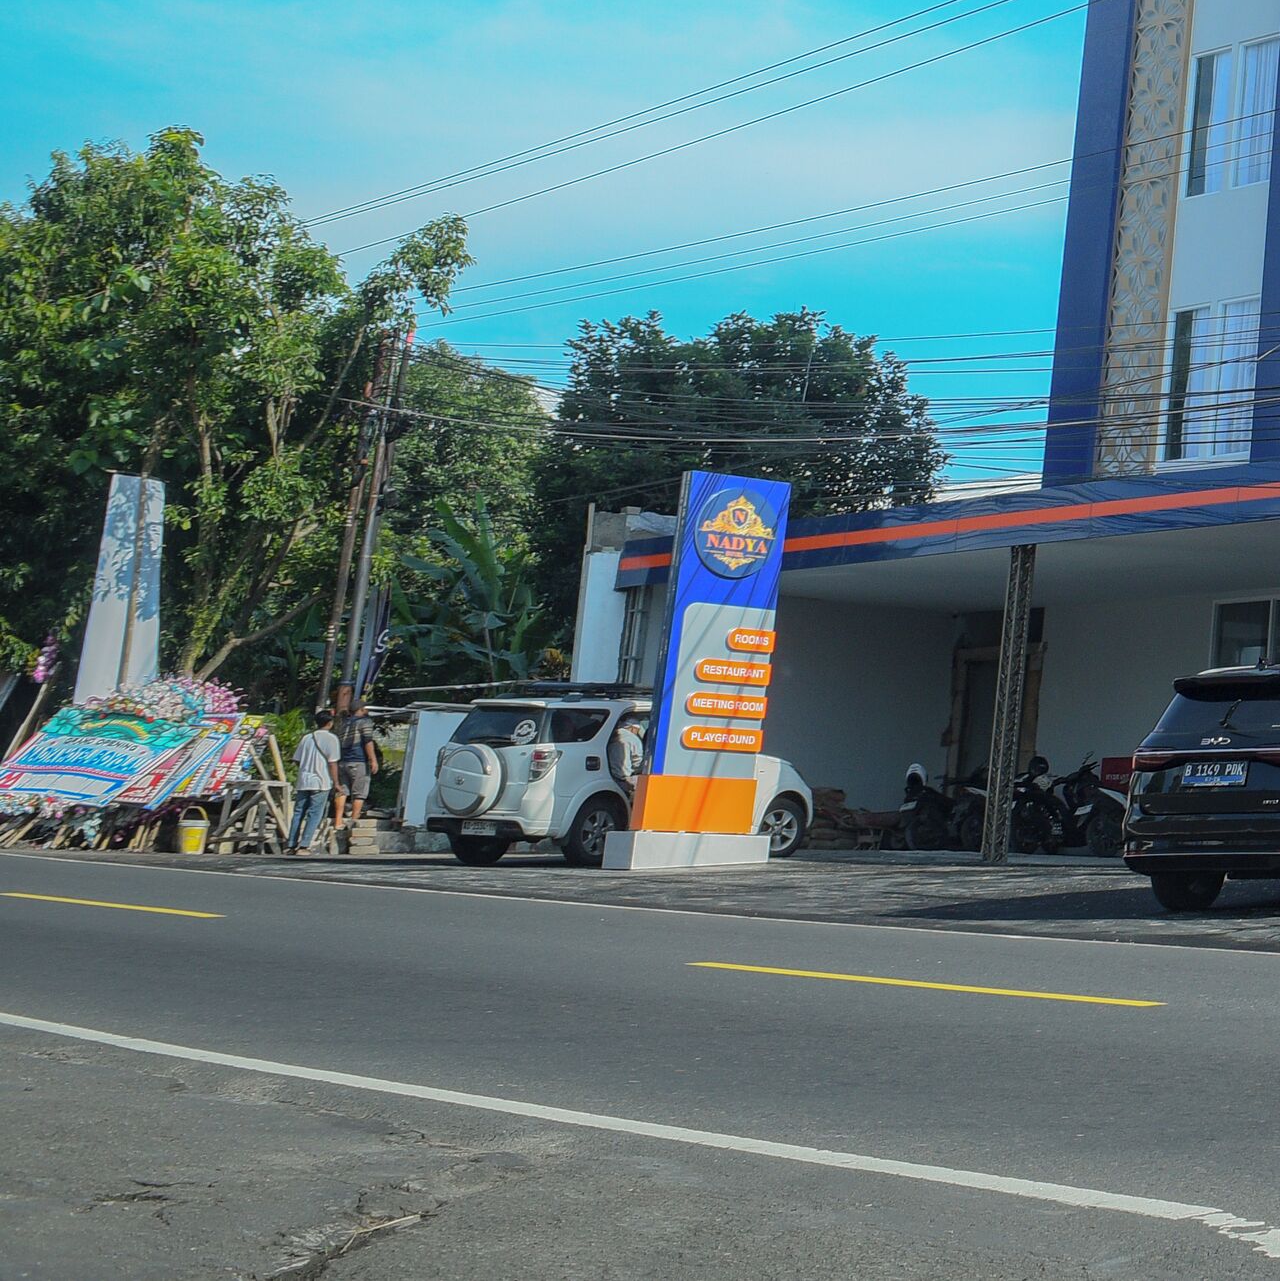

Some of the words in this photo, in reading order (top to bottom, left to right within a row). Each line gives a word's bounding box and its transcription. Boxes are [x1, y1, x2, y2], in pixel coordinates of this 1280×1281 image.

[706, 533, 768, 553] NADYA
[735, 633, 770, 647] ROOMS
[703, 664, 765, 679] RESTAURANT
[692, 698, 735, 710] MEETING
[734, 701, 764, 712] ROOM
[691, 731, 756, 745] PLAYGROUND
[1200, 737, 1231, 746] BYD
[1185, 765, 1191, 776] B
[1195, 764, 1221, 776] 1149
[1225, 763, 1244, 776] PDK
